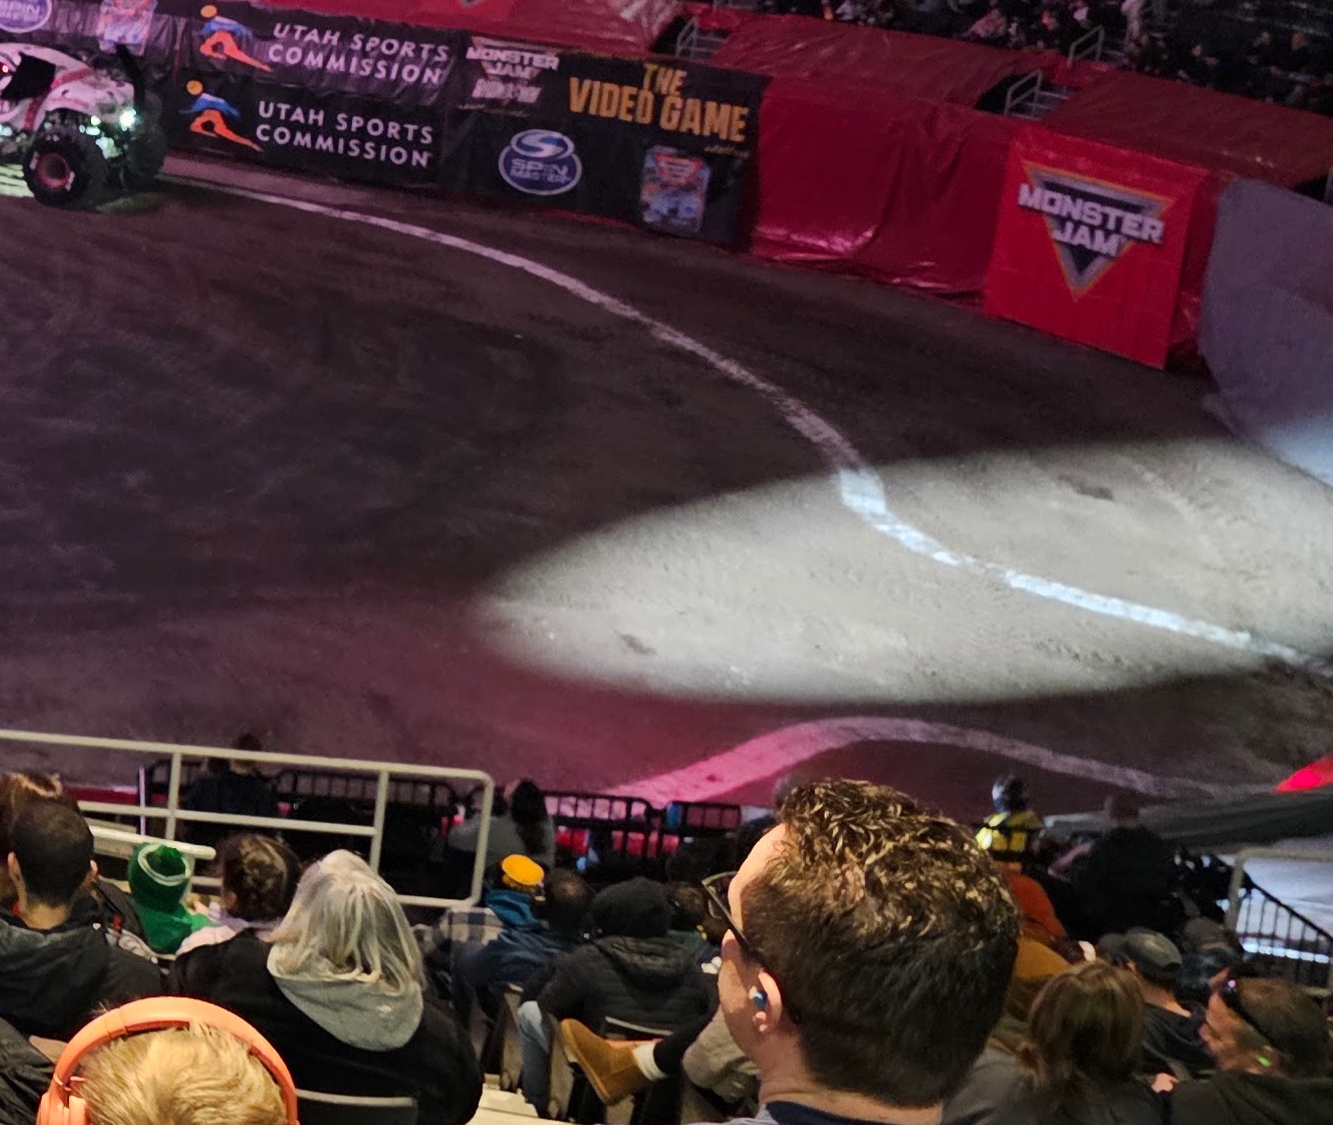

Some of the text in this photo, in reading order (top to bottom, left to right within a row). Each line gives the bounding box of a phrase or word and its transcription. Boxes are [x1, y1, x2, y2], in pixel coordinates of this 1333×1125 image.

[273, 23, 449, 62] UTAH SPORTS
[268, 44, 442, 85] COMMISSION
[644, 62, 687, 95] THE
[258, 100, 433, 145] UTAH SPORTS
[569, 77, 655, 124] VIDEO
[659, 94, 749, 142] GAME
[256, 124, 431, 168] COMMISSION
[1018, 183, 1166, 245] MONSTER
[1053, 222, 1121, 257] JAM
